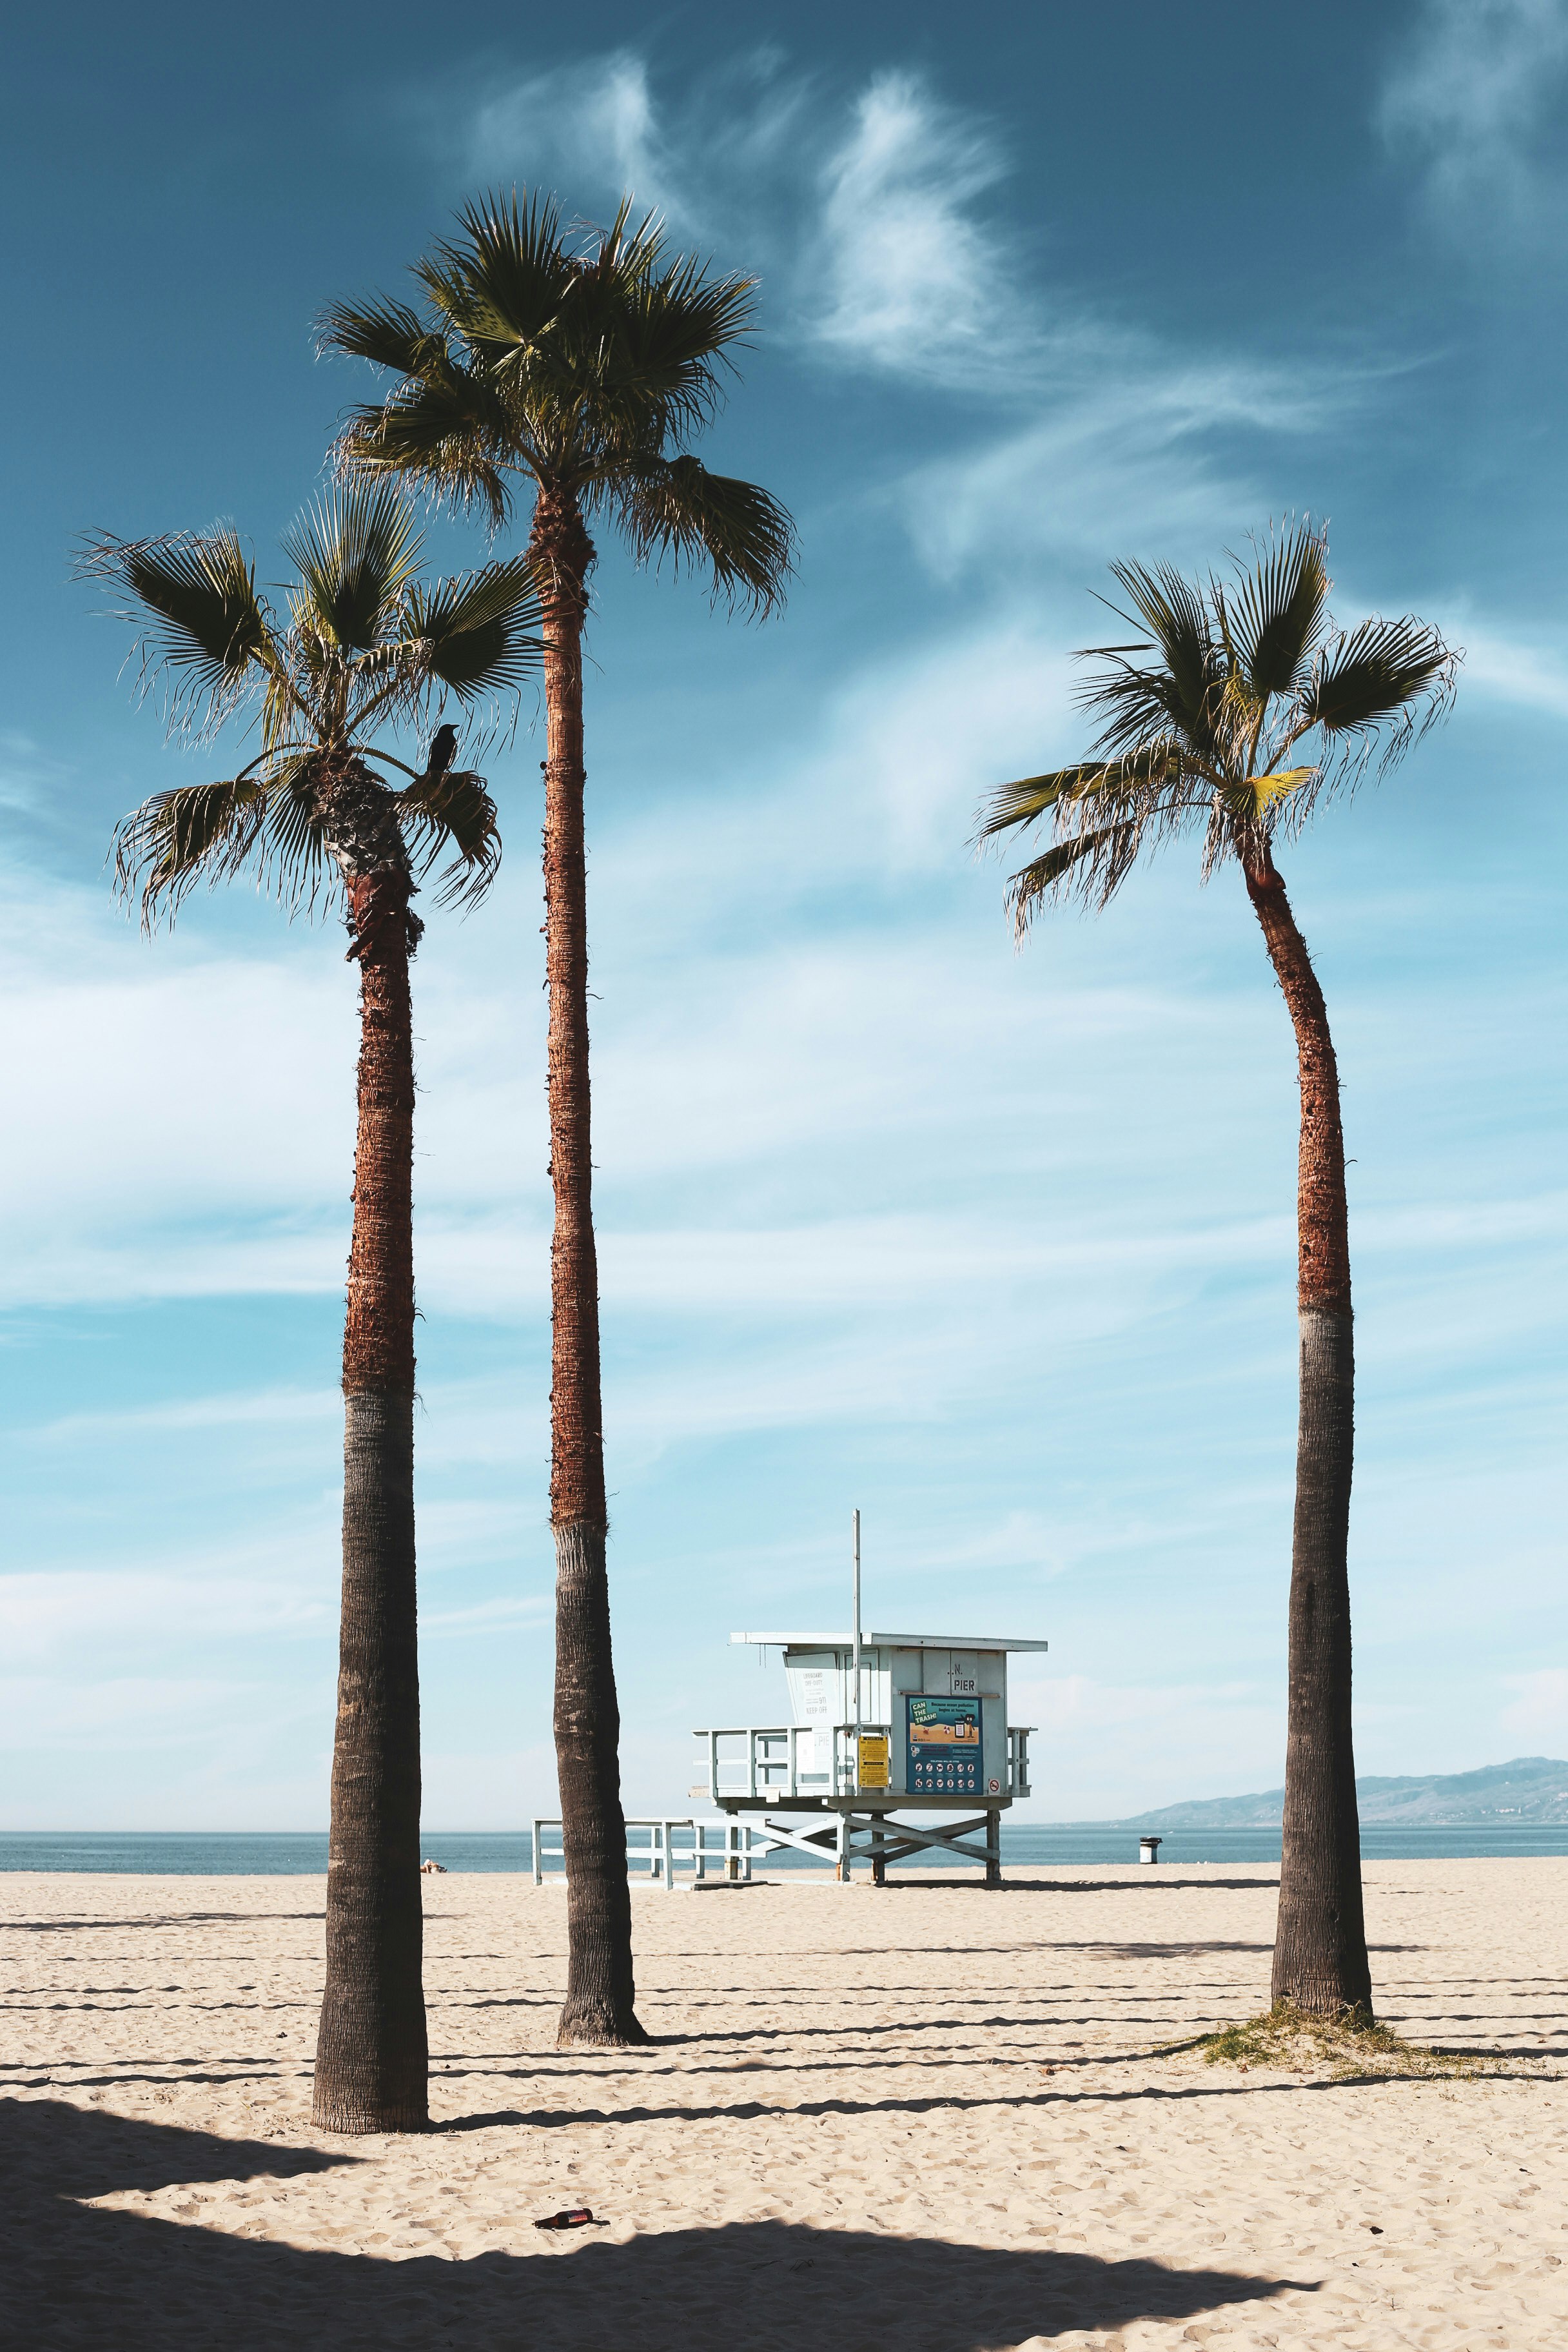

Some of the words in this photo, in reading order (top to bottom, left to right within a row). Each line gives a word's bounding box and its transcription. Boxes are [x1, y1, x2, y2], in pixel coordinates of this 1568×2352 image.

[954, 1680, 975, 1690] PIER
[913, 1701, 926, 1710] CAN
[915, 1712, 937, 1723] TRASH!
[818, 1735, 830, 1746] PIE
